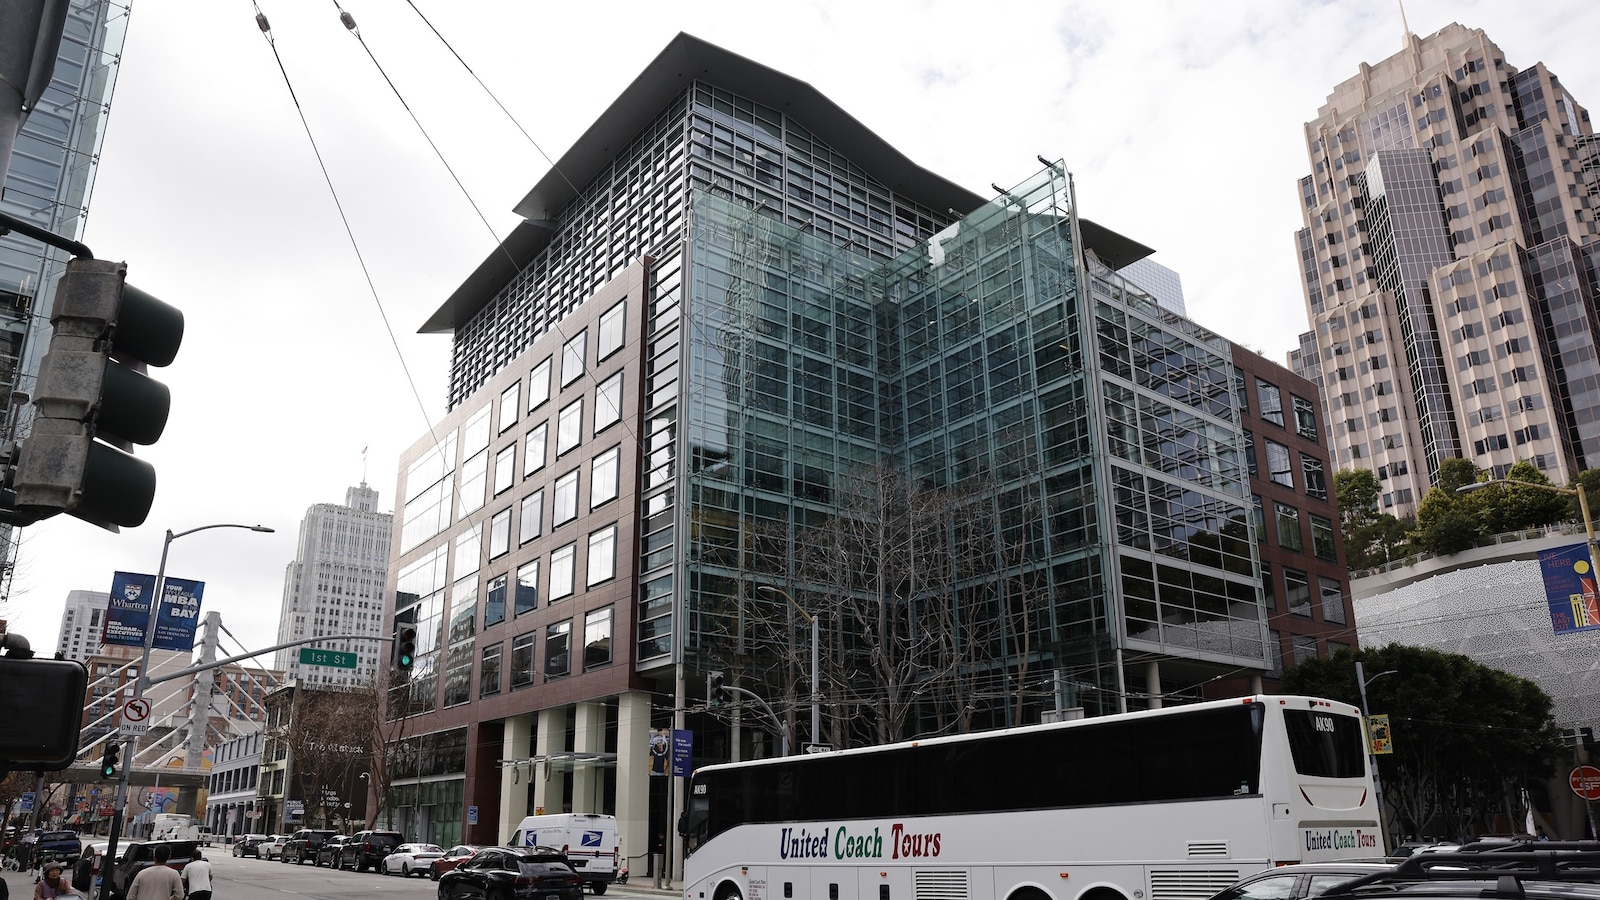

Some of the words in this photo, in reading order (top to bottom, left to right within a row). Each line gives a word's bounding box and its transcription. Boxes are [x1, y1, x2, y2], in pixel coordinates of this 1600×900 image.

[1547, 558, 1572, 568] HERE
[112, 598, 148, 610] Wharton
[164, 594, 198, 607] MBA
[170, 607, 197, 619] BAY
[1553, 617, 1571, 625] EAST
[1554, 623, 1569, 631] CUT
[106, 629, 143, 637] EXECUTIVES
[311, 653, 327, 663] 1st
[334, 655, 346, 664] St
[1315, 716, 1335, 732] AK90
[1579, 782, 1600, 790] SF
[780, 827, 829, 860] United
[834, 825, 883, 860] Coach
[891, 823, 941, 860] Tours
[1305, 830, 1332, 851] United
[1333, 829, 1356, 850] Coach
[1356, 829, 1376, 849] Tours
